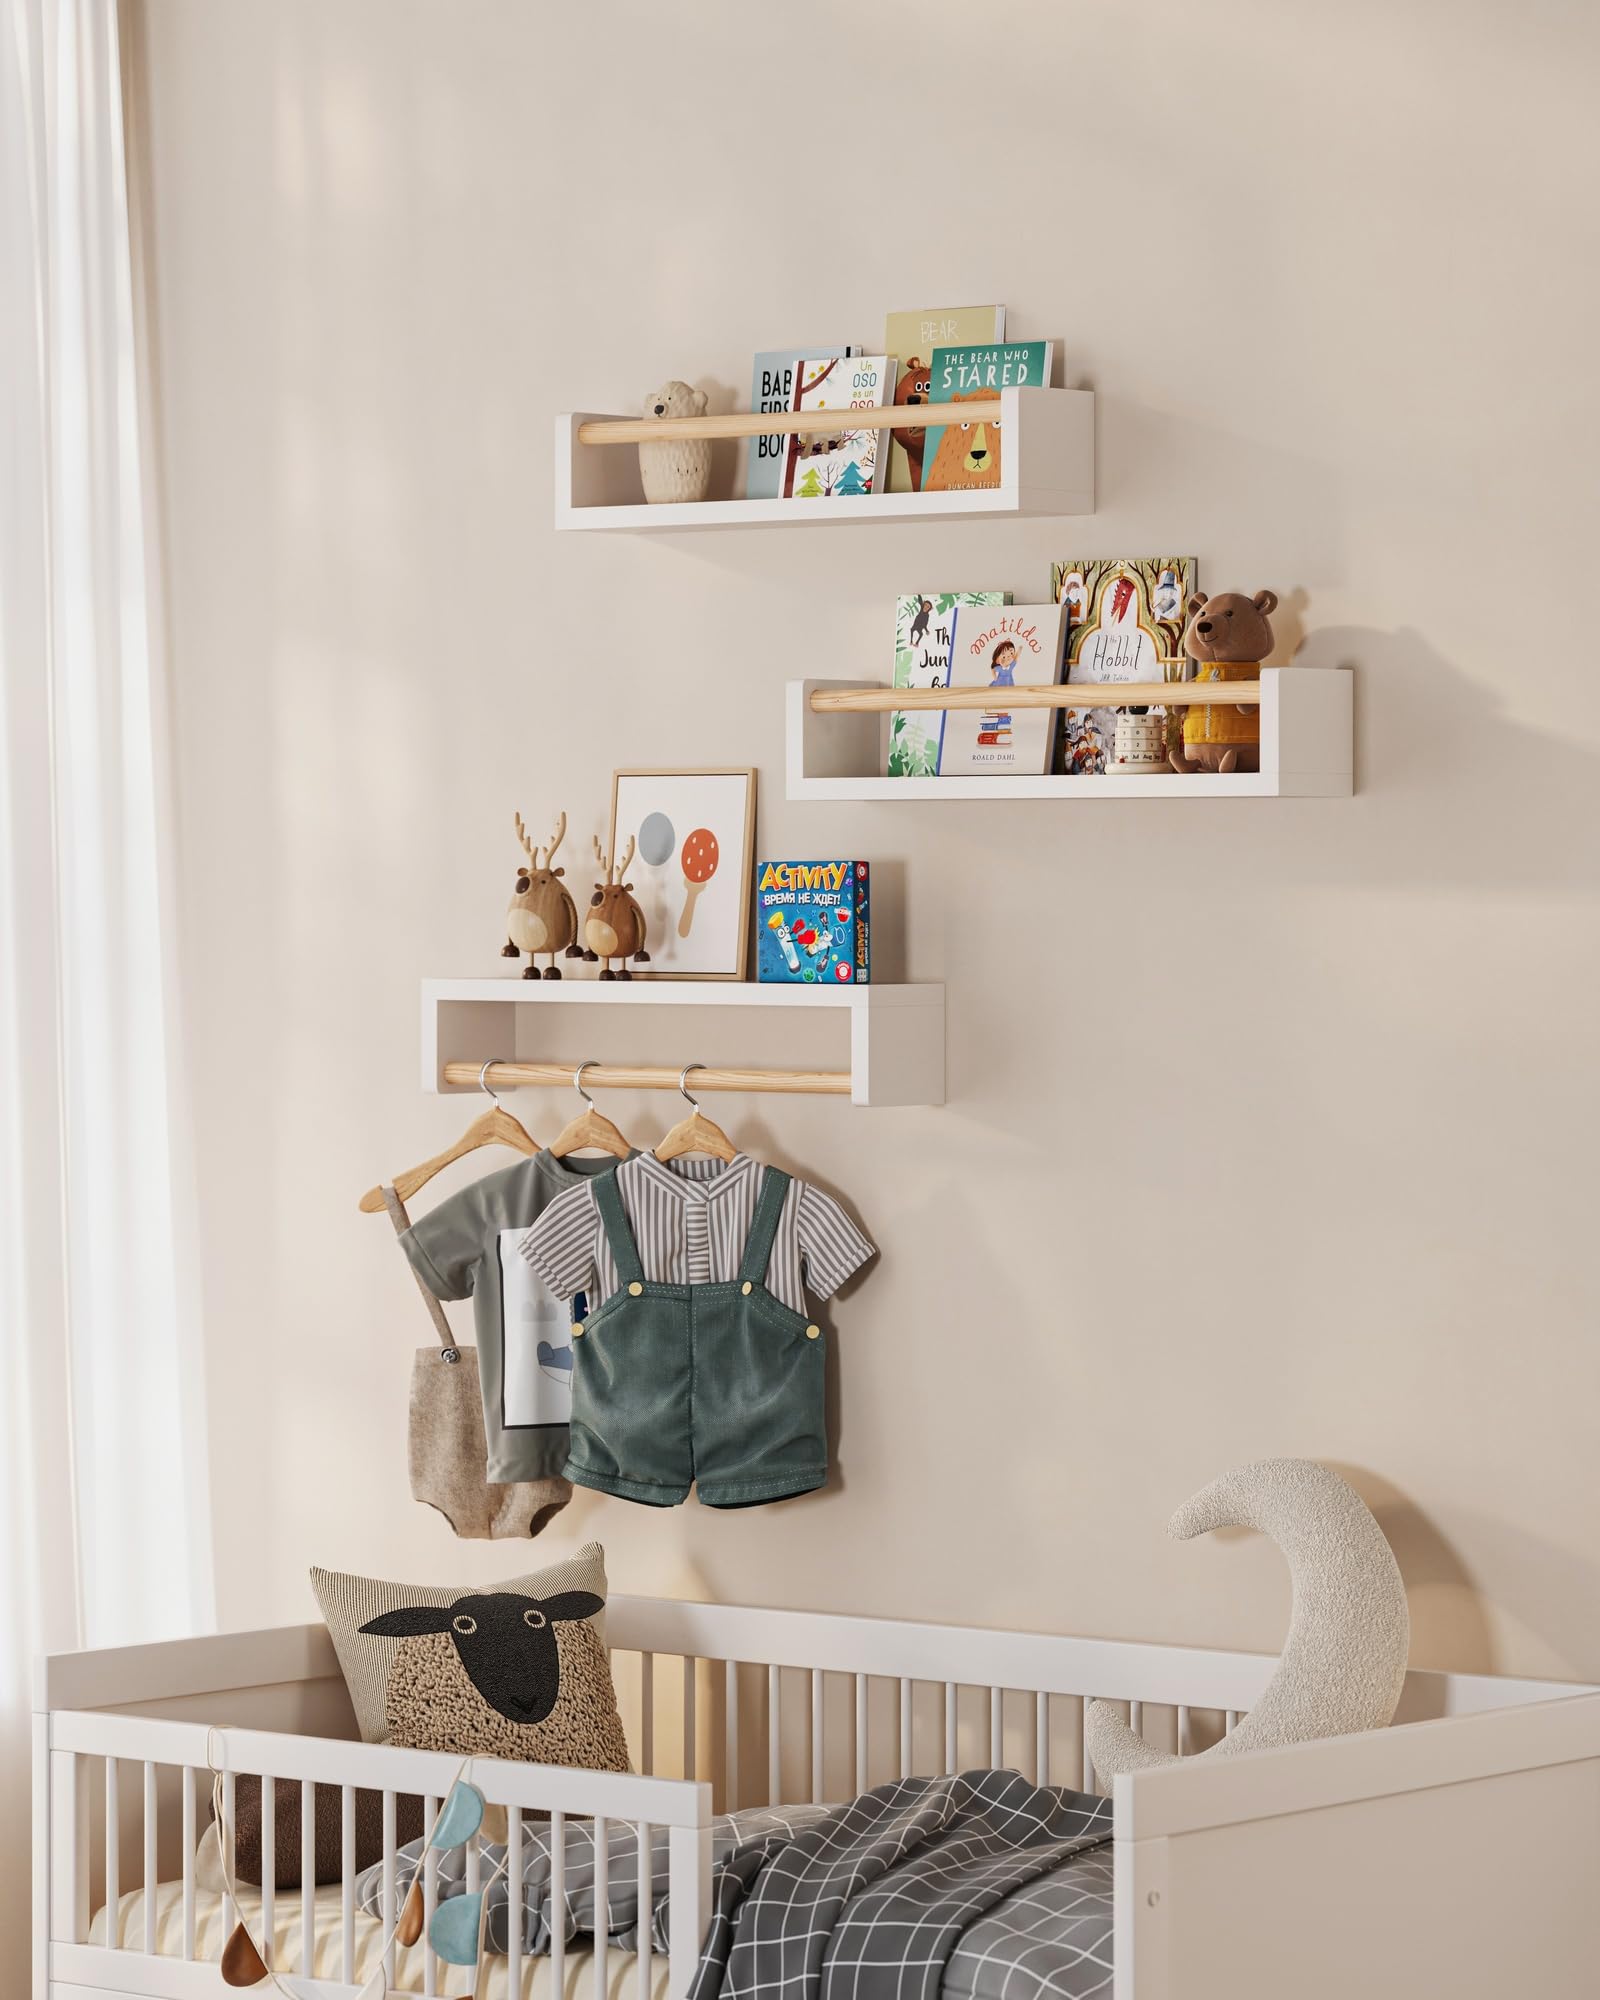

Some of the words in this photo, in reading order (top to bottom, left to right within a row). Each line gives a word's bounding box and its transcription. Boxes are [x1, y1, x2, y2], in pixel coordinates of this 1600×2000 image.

[920, 319, 959, 344] BEAR
[860, 361, 873, 371] Un
[944, 353, 965, 365] THE
[970, 351, 998, 363] BEAR
[1004, 349, 1029, 361] WHO
[942, 363, 1028, 389] STARED
[864, 390, 874, 398] un
[919, 649, 948, 669] Jun
[1092, 634, 1142, 671] Hobbit
[759, 862, 848, 892] ACTIVITY
[764, 892, 796, 906] ВРЕМЯ
[798, 892, 811, 904] НЕ
[812, 893, 841, 907] ЖДЕТ!
